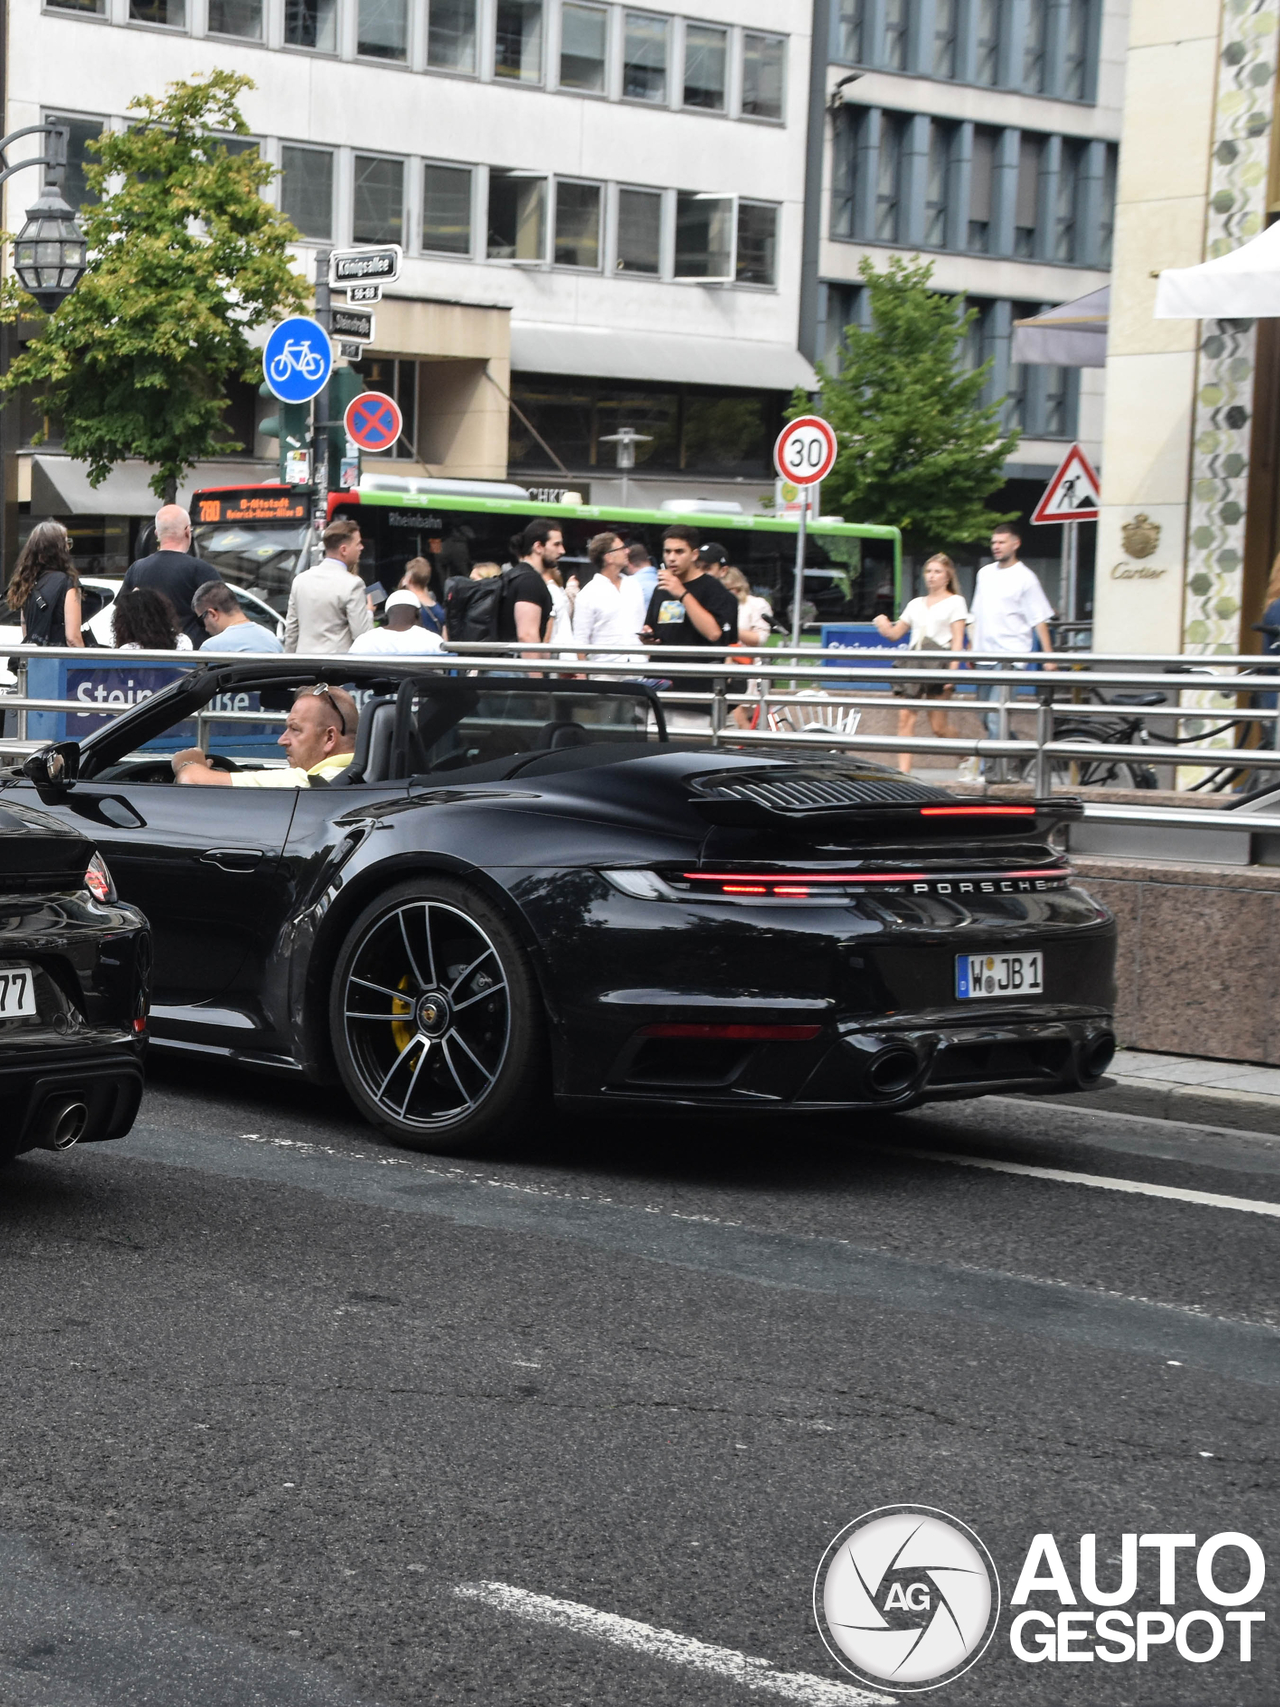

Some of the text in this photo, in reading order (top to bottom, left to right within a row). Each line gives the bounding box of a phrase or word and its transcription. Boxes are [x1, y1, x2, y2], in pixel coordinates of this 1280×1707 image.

[338, 257, 389, 276] Königsallee
[789, 438, 823, 467] 30
[199, 500, 221, 522] 780
[388, 512, 442, 529] Rheinbahn
[1110, 562, 1168, 580] Cartier
[913, 880, 1047, 894] PORSCHE
[971, 956, 1041, 992] W JB 1
